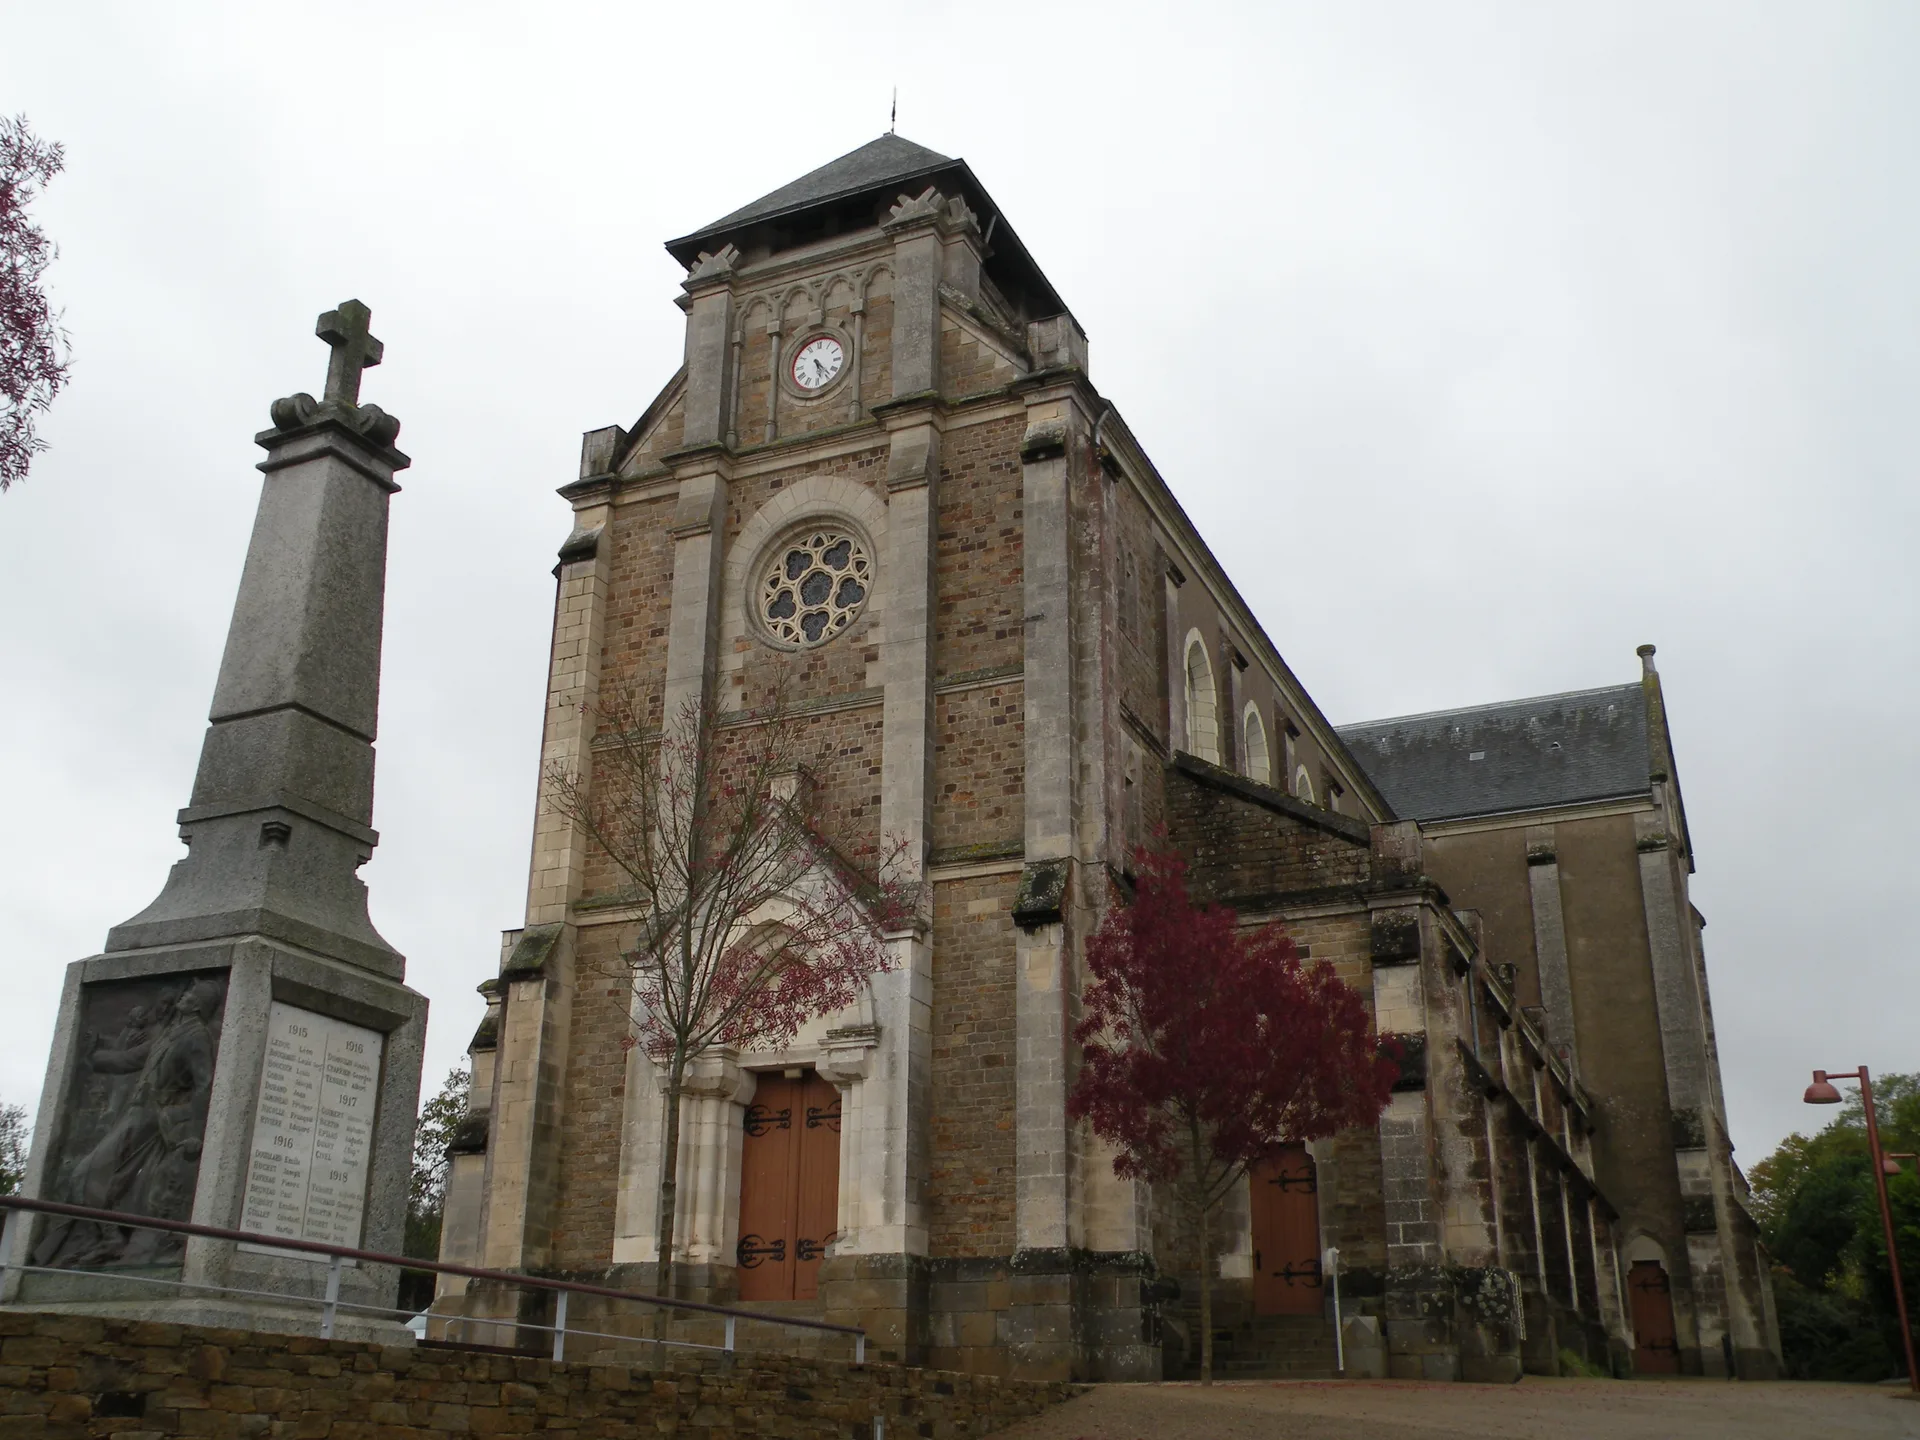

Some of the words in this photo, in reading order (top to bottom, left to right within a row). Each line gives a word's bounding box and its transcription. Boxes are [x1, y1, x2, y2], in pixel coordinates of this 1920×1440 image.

[288, 1024, 308, 1038] 1915
[346, 1040, 364, 1054] 1916
[339, 1094, 357, 1107] 1917
[274, 1135, 294, 1149] 1916
[330, 1170, 348, 1183] 1918
